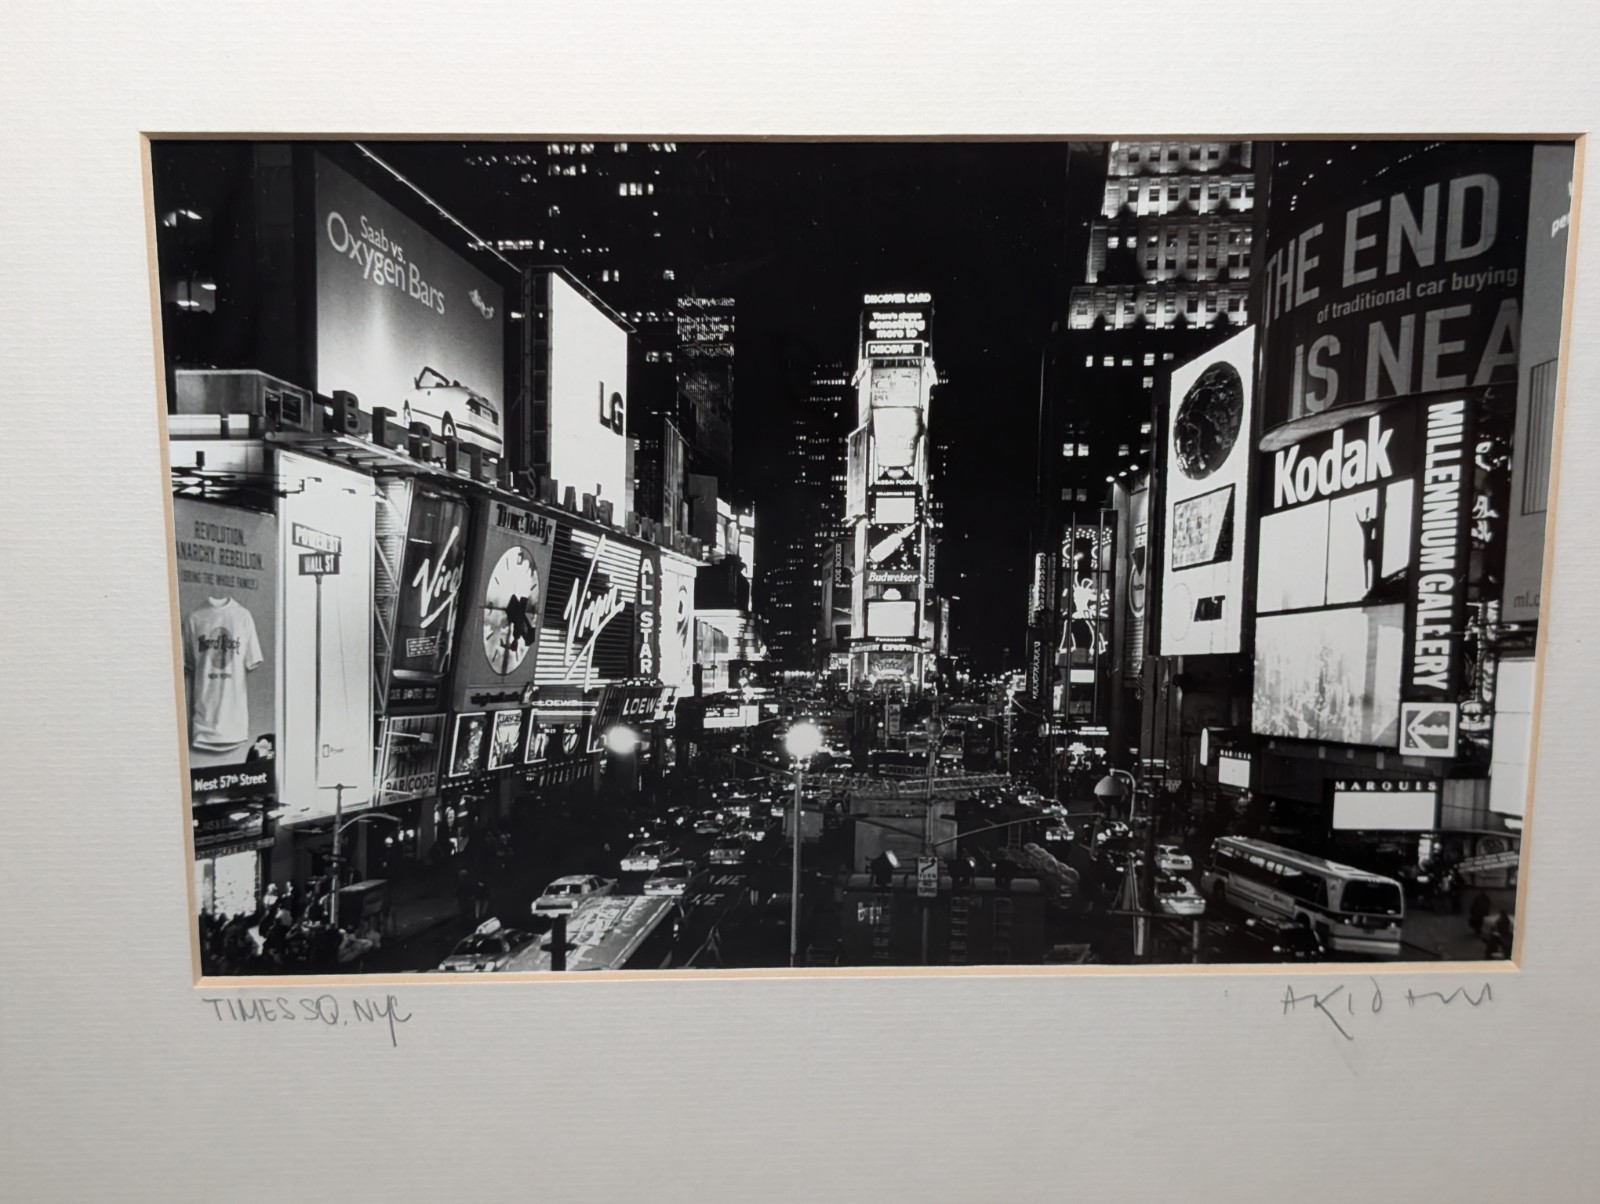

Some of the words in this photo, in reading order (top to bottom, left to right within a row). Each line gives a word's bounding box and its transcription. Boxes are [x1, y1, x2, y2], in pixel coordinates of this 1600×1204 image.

[327, 211, 406, 291] Oxygen
[409, 262, 445, 315] Bars
[360, 215, 389, 252] Saab
[391, 241, 406, 264] vs.
[1264, 222, 1324, 328] THE
[1342, 173, 1500, 288] END
[1317, 304, 1330, 324] of
[1332, 282, 1412, 319] traditional
[1416, 278, 1448, 297] car
[1451, 268, 1519, 293] buying
[1290, 334, 1342, 423] IS
[599, 380, 624, 437] LG
[1273, 415, 1394, 509] Kodak
[1419, 399, 1466, 572] MILLENNIUM
[194, 520, 247, 547] REVOLUTION.
[928, 542, 936, 558] JOE
[219, 547, 265, 571] REBELLION.
[304, 555, 323, 573] WALL
[324, 554, 335, 572] ST
[640, 558, 653, 606] ALL
[868, 571, 919, 583] Budweiser
[928, 558, 936, 583] BOXER
[563, 534, 625, 693] Virgin
[1412, 573, 1455, 691] GALLERY
[640, 611, 654, 674] STAR
[622, 697, 662, 716] LOEWS
[193, 778, 218, 792] West
[219, 774, 239, 789] 57th
[240, 772, 268, 786] Street
[408, 774, 436, 792] CODE
[1334, 780, 1438, 792] MARQUIS
[202, 997, 296, 1022] TIMES
[353, 994, 413, 1048] NYC
